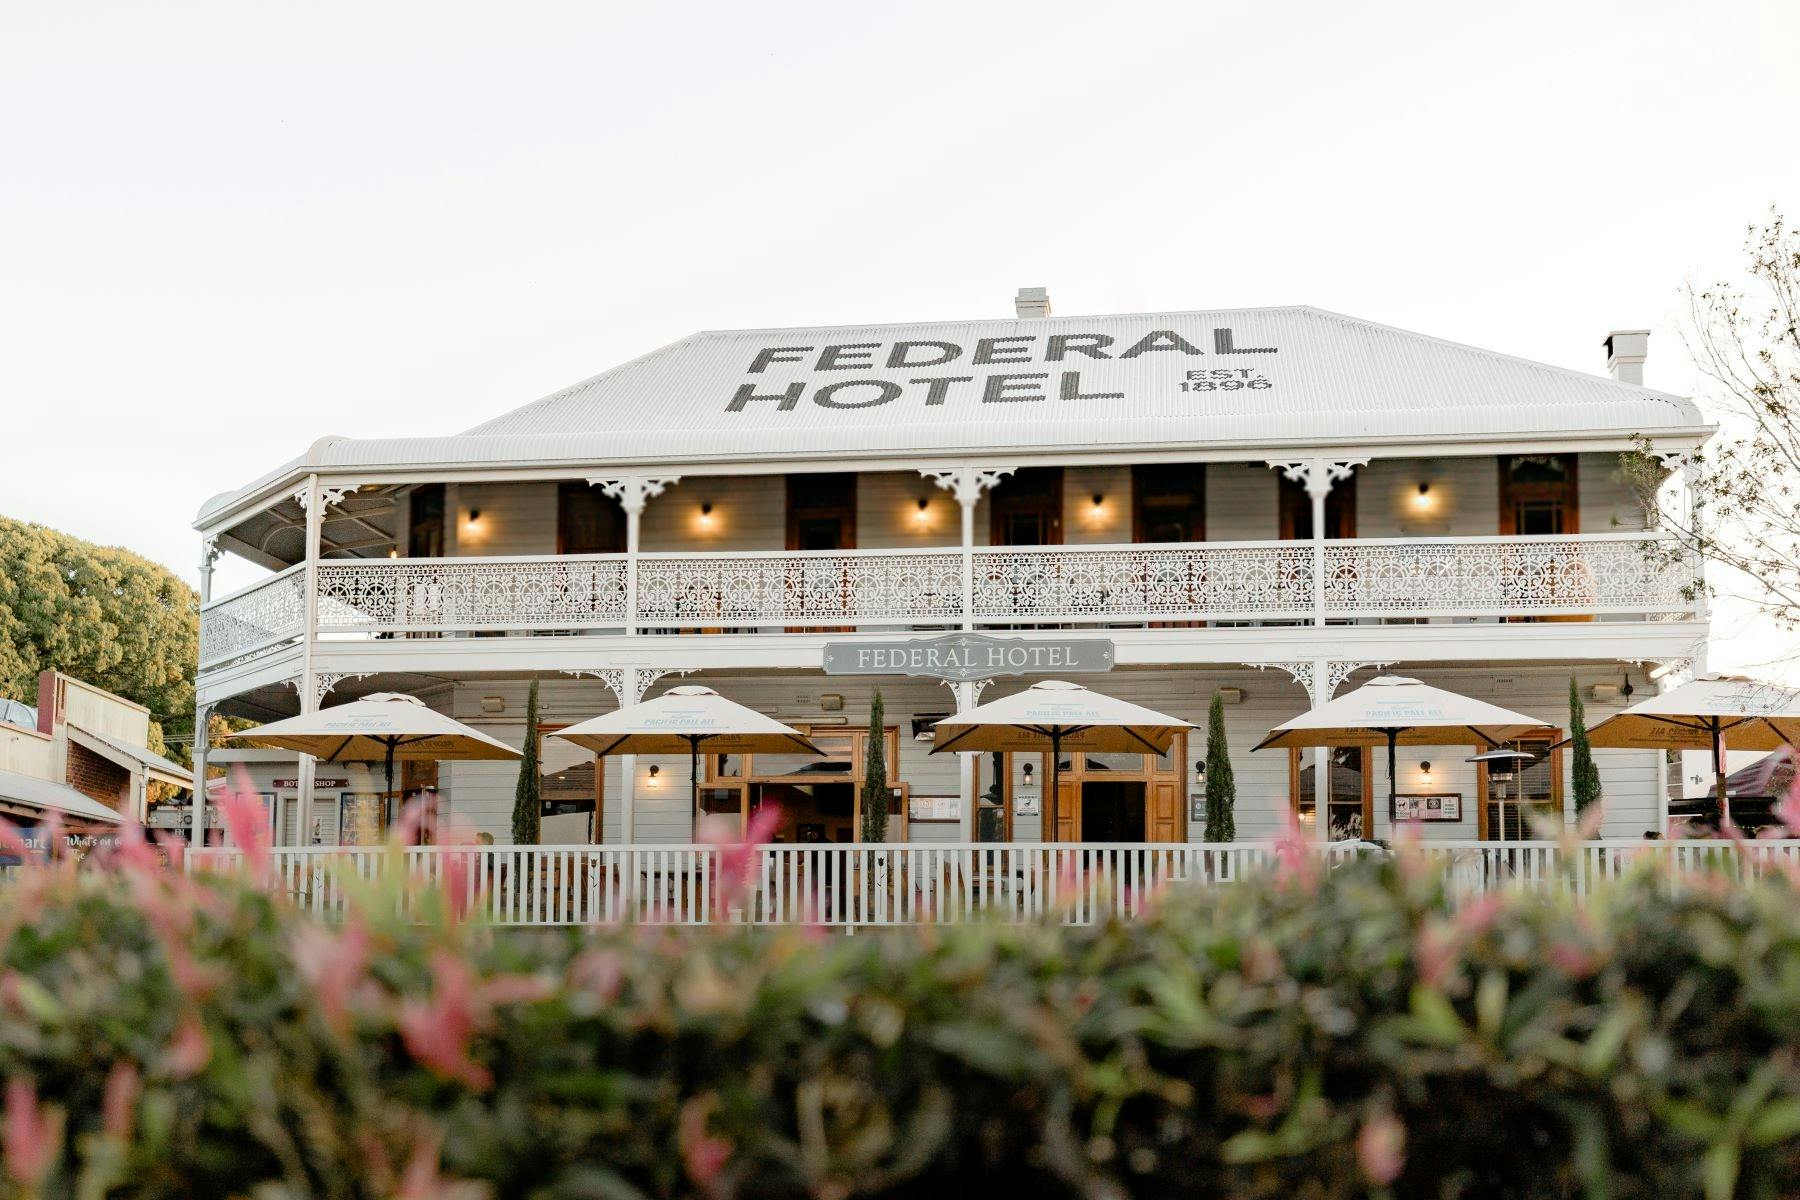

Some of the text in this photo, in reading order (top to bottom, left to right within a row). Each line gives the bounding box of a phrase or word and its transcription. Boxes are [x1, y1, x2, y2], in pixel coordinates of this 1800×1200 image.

[748, 328, 1278, 374] FEDERAL
[724, 371, 1125, 412] HOTEL
[1178, 380, 1272, 392] 1896
[857, 646, 1079, 668] FEDERAL HOTEL
